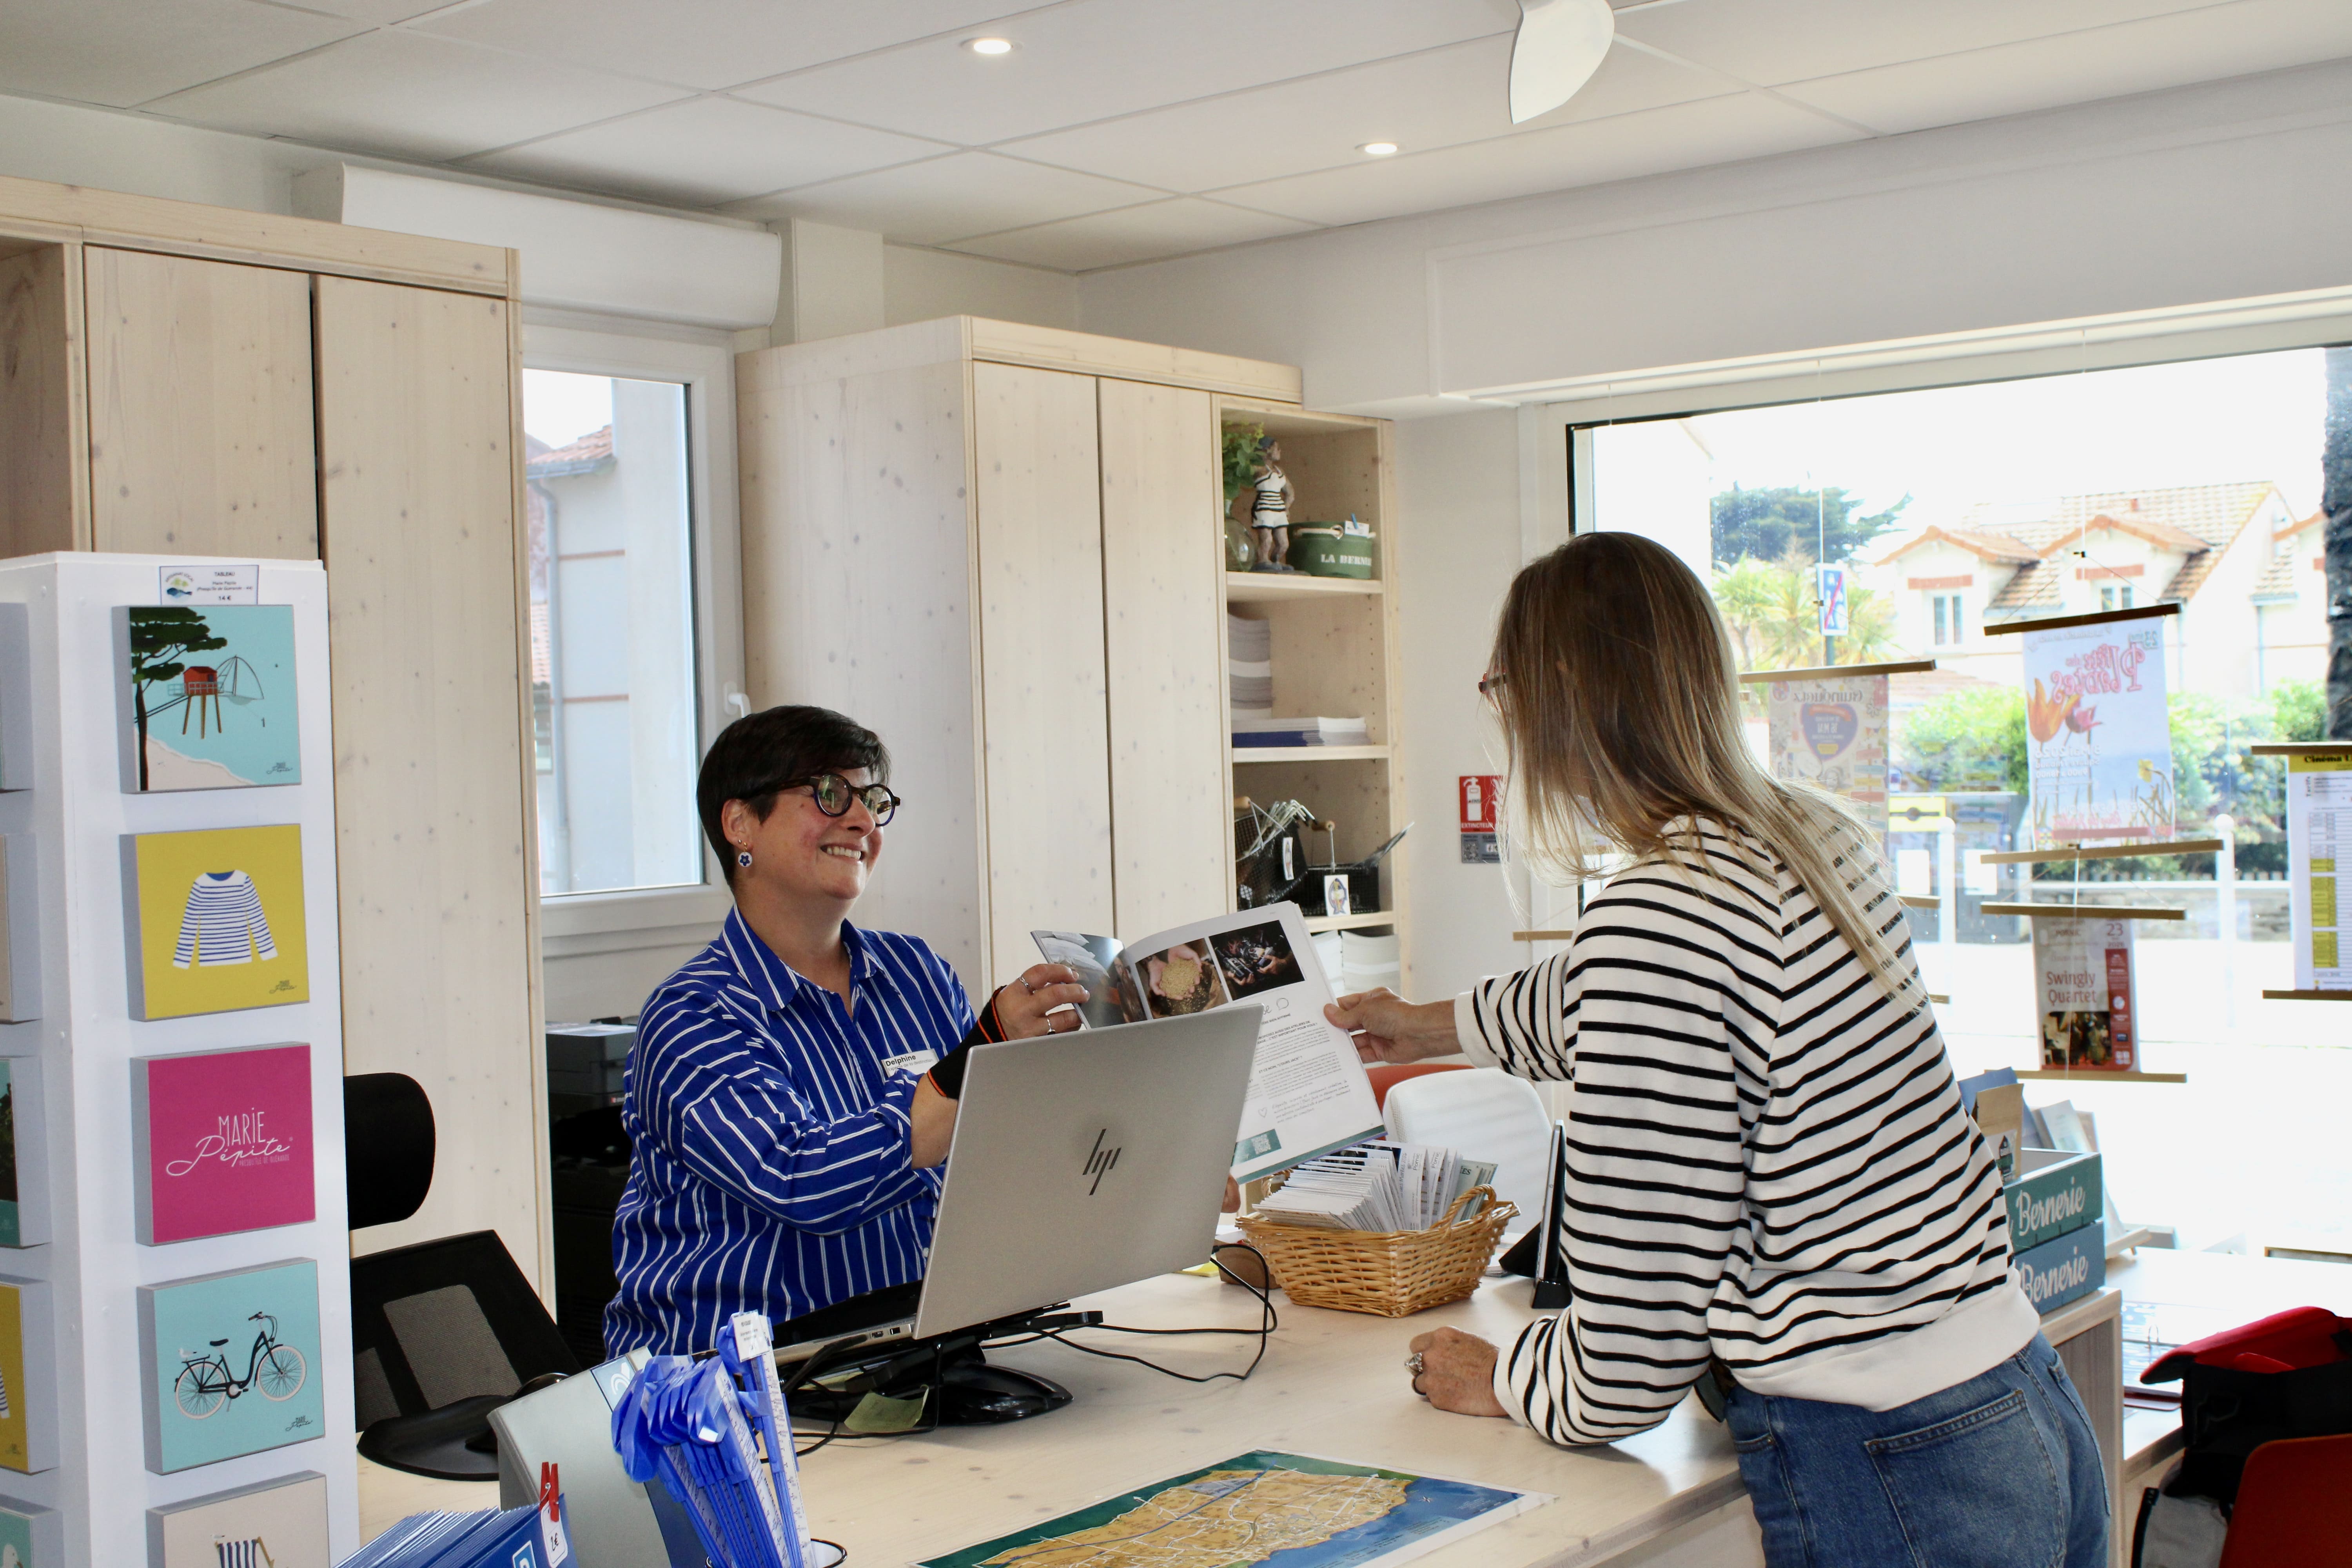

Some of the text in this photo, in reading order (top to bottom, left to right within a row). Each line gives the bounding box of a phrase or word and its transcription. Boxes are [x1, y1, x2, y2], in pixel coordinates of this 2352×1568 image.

[1321, 554, 1336, 563] LA
[2106, 923, 2124, 937] 23
[2047, 971, 2096, 988] Swingly
[2048, 989, 2096, 1006] Quartet
[1278, 1029, 1297, 1037] IMPORTANT
[886, 1055, 916, 1066] Delphine
[218, 1107, 266, 1147] MARIE
[166, 1135, 290, 1176] Pépite
[1082, 1129, 1122, 1196] hp
[1431, 1152, 1441, 1169] Pornic
[2015, 1176, 2085, 1236] Bernerie
[2019, 1245, 2089, 1303] Bernerie
